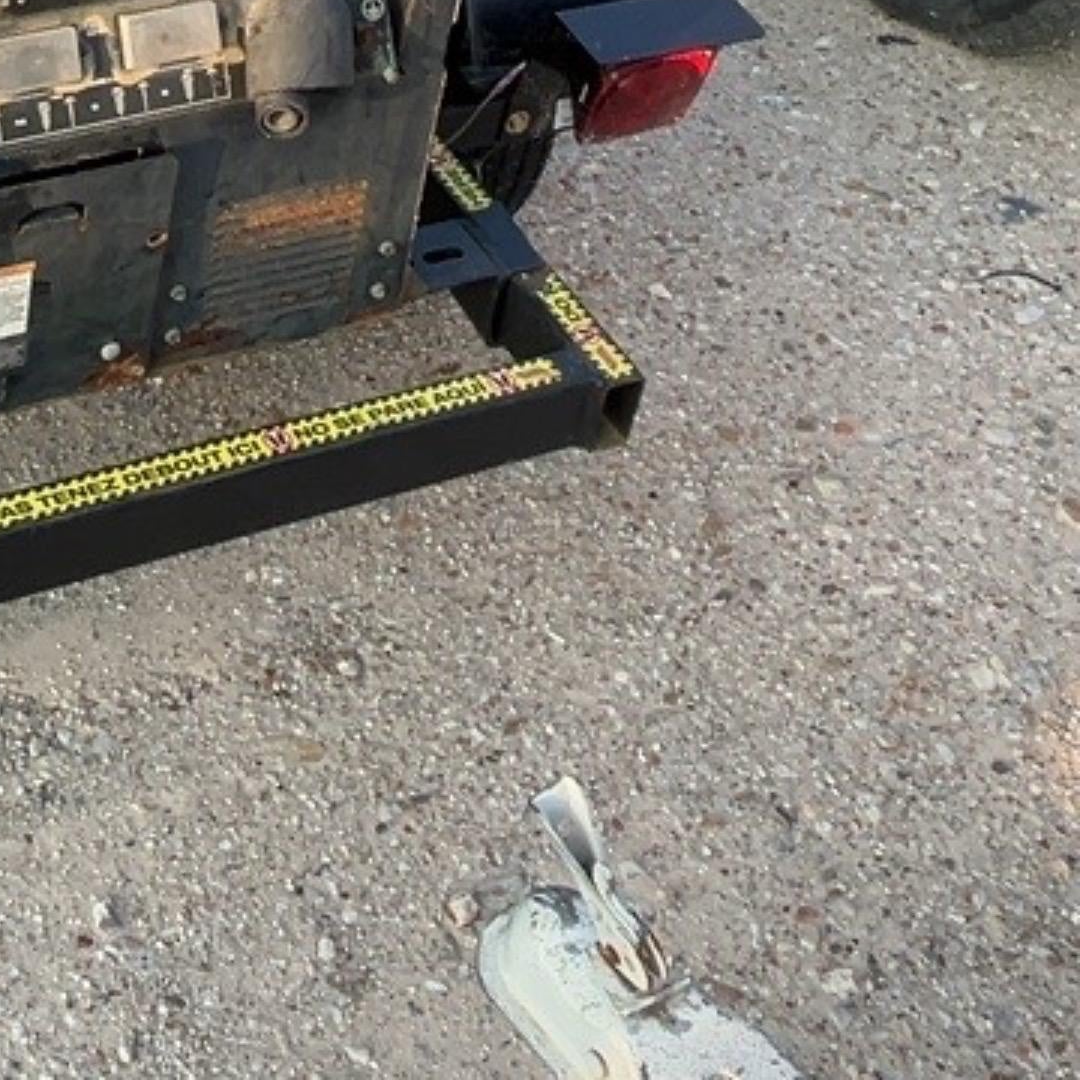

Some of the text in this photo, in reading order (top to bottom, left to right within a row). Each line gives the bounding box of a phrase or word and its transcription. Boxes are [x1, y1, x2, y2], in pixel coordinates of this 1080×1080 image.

[40, 479, 121, 510] TENEZ
[123, 452, 225, 485] DEBOUT
[228, 441, 263, 457] ICI
[293, 422, 329, 440] NO
[372, 395, 429, 421] PARE
